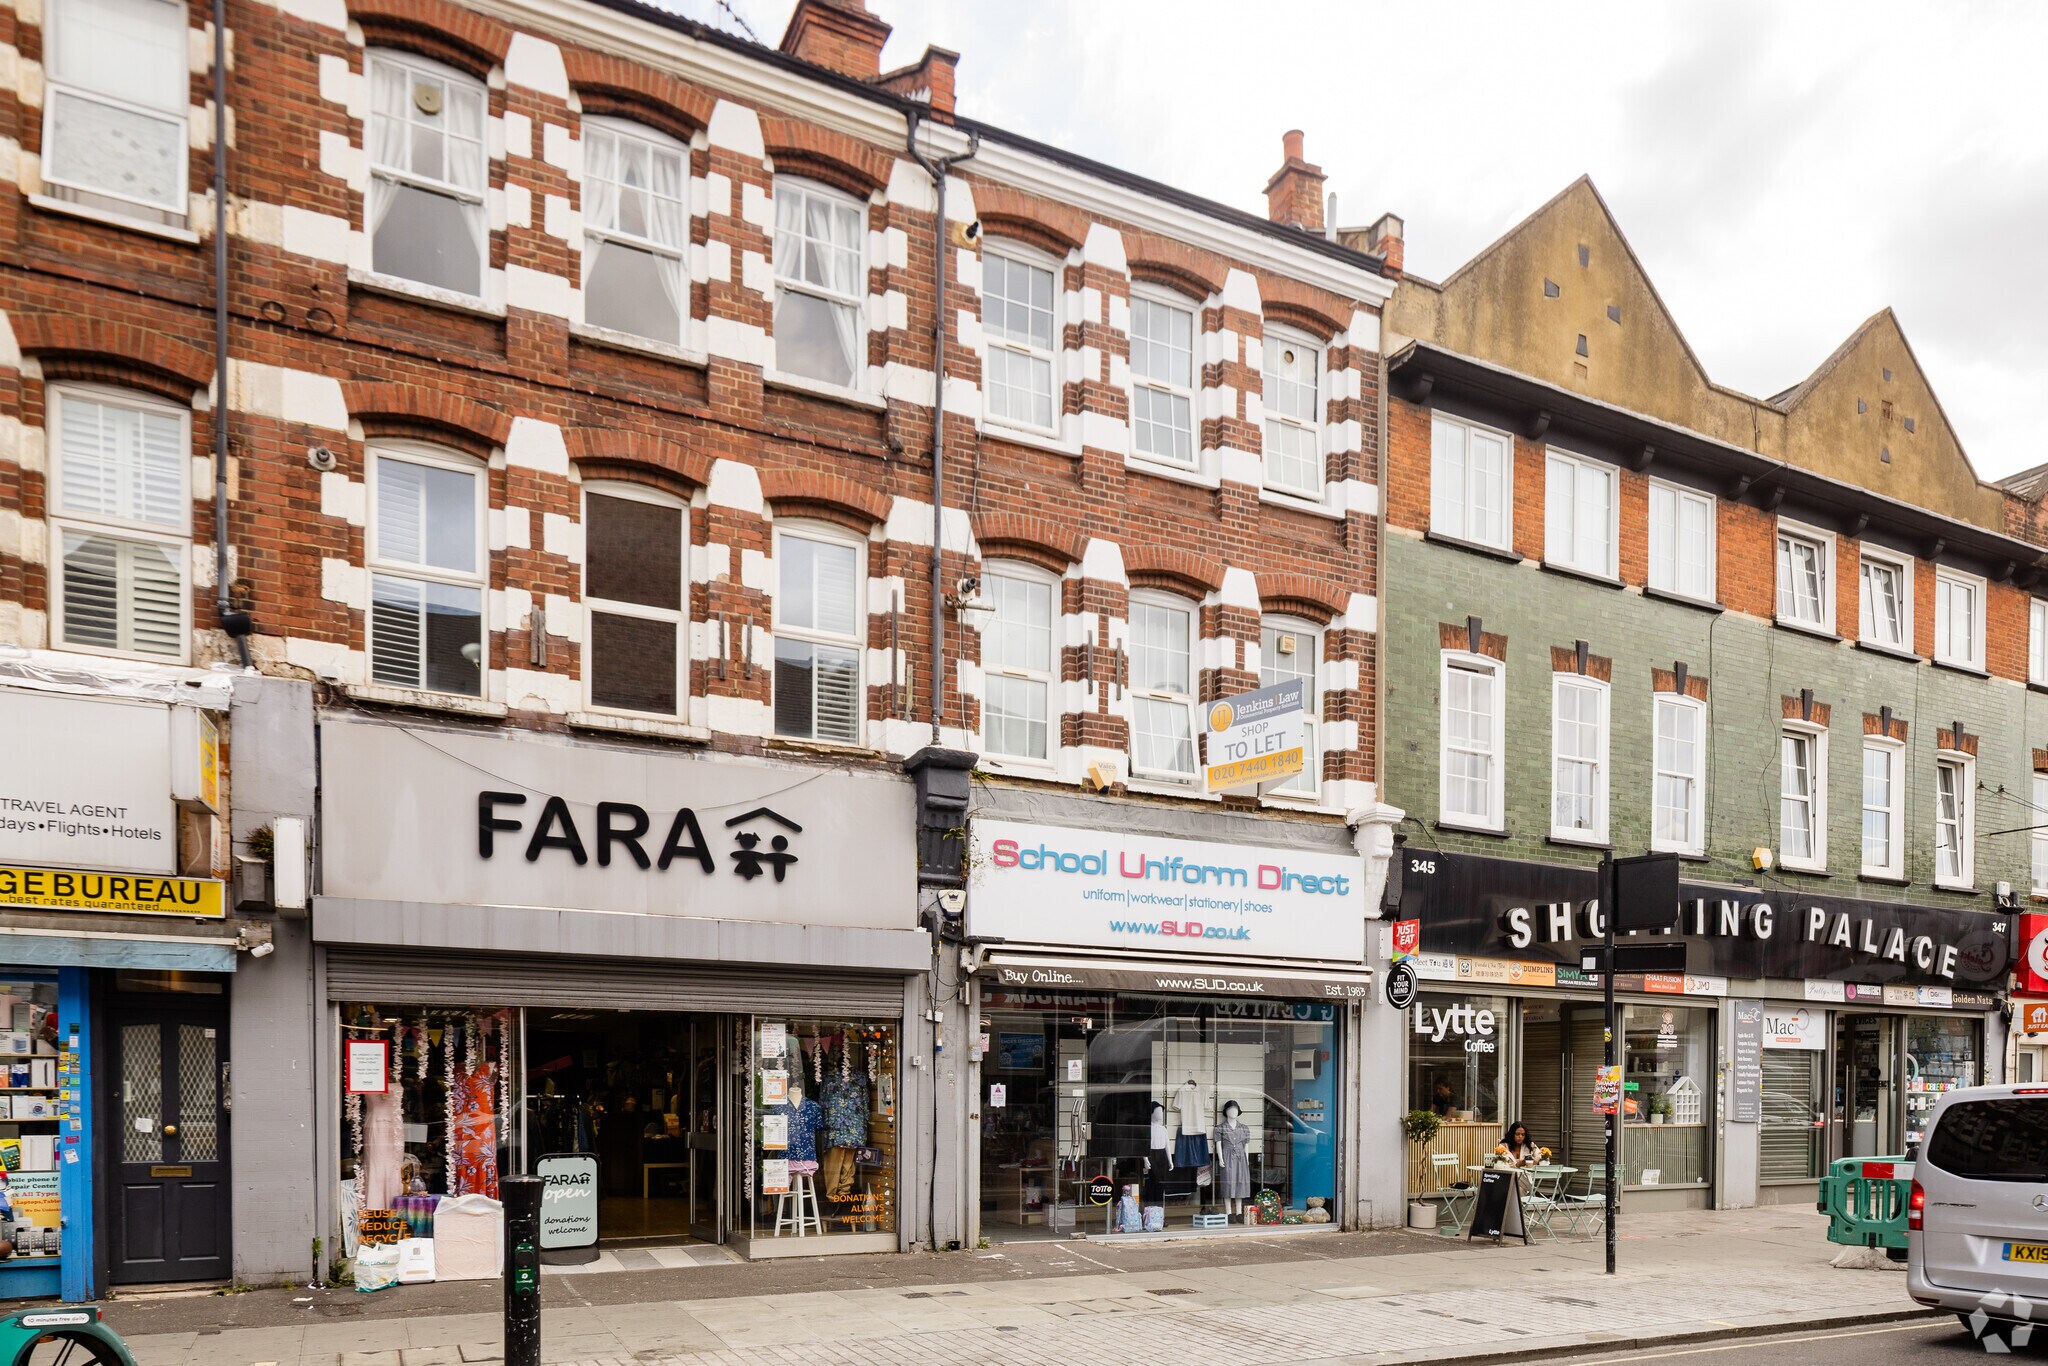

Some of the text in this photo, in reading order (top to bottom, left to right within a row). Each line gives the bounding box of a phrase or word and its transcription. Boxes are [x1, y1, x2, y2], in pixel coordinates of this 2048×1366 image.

[1236, 690, 1299, 720] Jenkins Law
[1241, 722, 1269, 738] SHOP
[1224, 731, 1286, 760] TO LET
[1213, 751, 1299, 780] 020 7440 1840
[0, 797, 128, 819] TRAVEL AGENT
[479, 790, 715, 874] FARA
[992, 838, 1350, 897] School Uniform Direct
[1411, 859, 1436, 874] 345
[43, 898, 80, 907] rates
[1109, 919, 1251, 941] www.SUD.co.uk
[1396, 923, 1415, 945] JUST EAT
[1992, 922, 2007, 933] 347
[1509, 898, 1958, 979] SHOING PALACE
[1523, 965, 1553, 974] DUMPLINS
[1004, 969, 1028, 985] Buy
[1396, 974, 1406, 982] FIT
[1663, 975, 1682, 984] FUSION
[1156, 977, 1265, 993] www.SUD.co.uk
[1325, 984, 1366, 997] Est. 1983
[1393, 980, 1409, 988] YOUR
[1393, 986, 1408, 994] MIND
[1953, 994, 1976, 1004] Golden
[1976, 995, 1993, 1005] Nata
[1415, 1001, 1495, 1043] Lytte
[1464, 1039, 1495, 1053] Coffee
[543, 1174, 580, 1187] FARA
[544, 1187, 591, 1203] open
[1091, 1185, 1113, 1193] TOTTO
[833, 1193, 885, 1203] DONATIONS
[357, 1209, 397, 1219] REUSE
[851, 1203, 885, 1213] ALWAYS
[544, 1215, 591, 1225] donations
[841, 1214, 885, 1224] WELCOME
[357, 1221, 408, 1231] REDUCE
[548, 1226, 588, 1235] welcome
